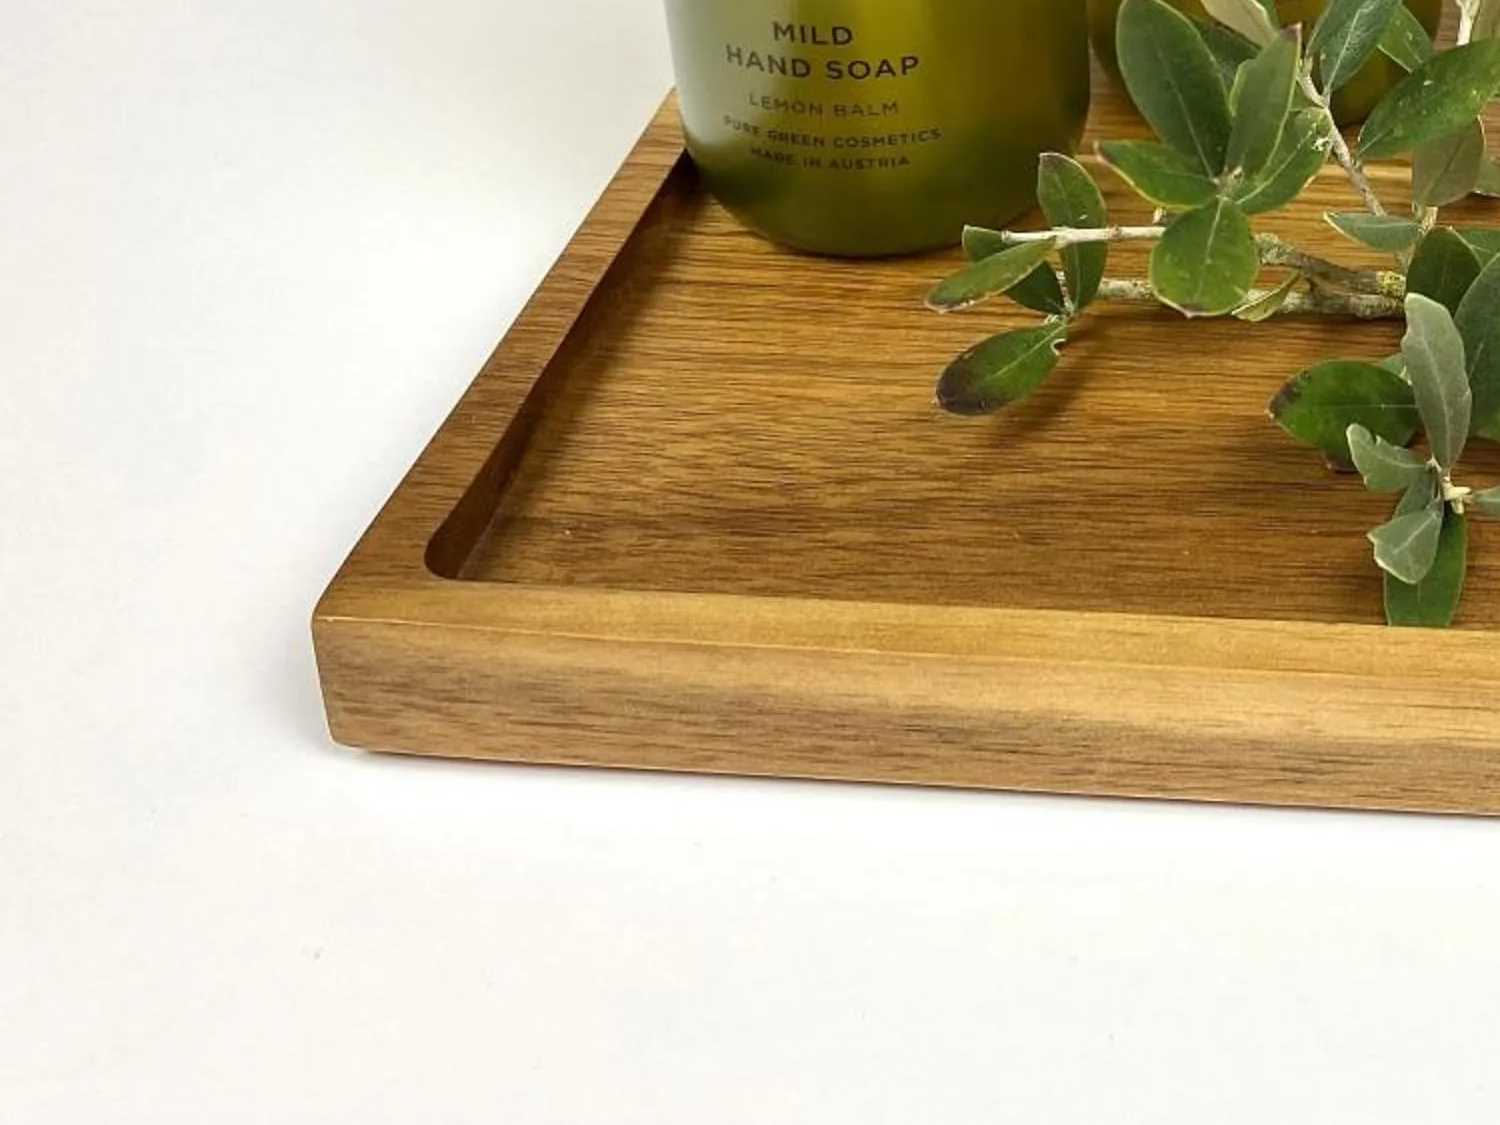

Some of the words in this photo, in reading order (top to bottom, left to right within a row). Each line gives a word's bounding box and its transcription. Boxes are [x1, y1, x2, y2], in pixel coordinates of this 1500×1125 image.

[772, 21, 854, 46] MILD
[726, 43, 811, 78] HAND
[826, 55, 919, 80] SOAP
[749, 93, 823, 116] LEMON
[834, 102, 899, 117] BALM
[724, 115, 759, 136] PURE
[768, 130, 825, 148] GREEN
[833, 128, 942, 148] COSMETICS
[751, 147, 795, 166] MADE
[803, 157, 821, 169] IN
[829, 156, 911, 170] AUSTRIA
